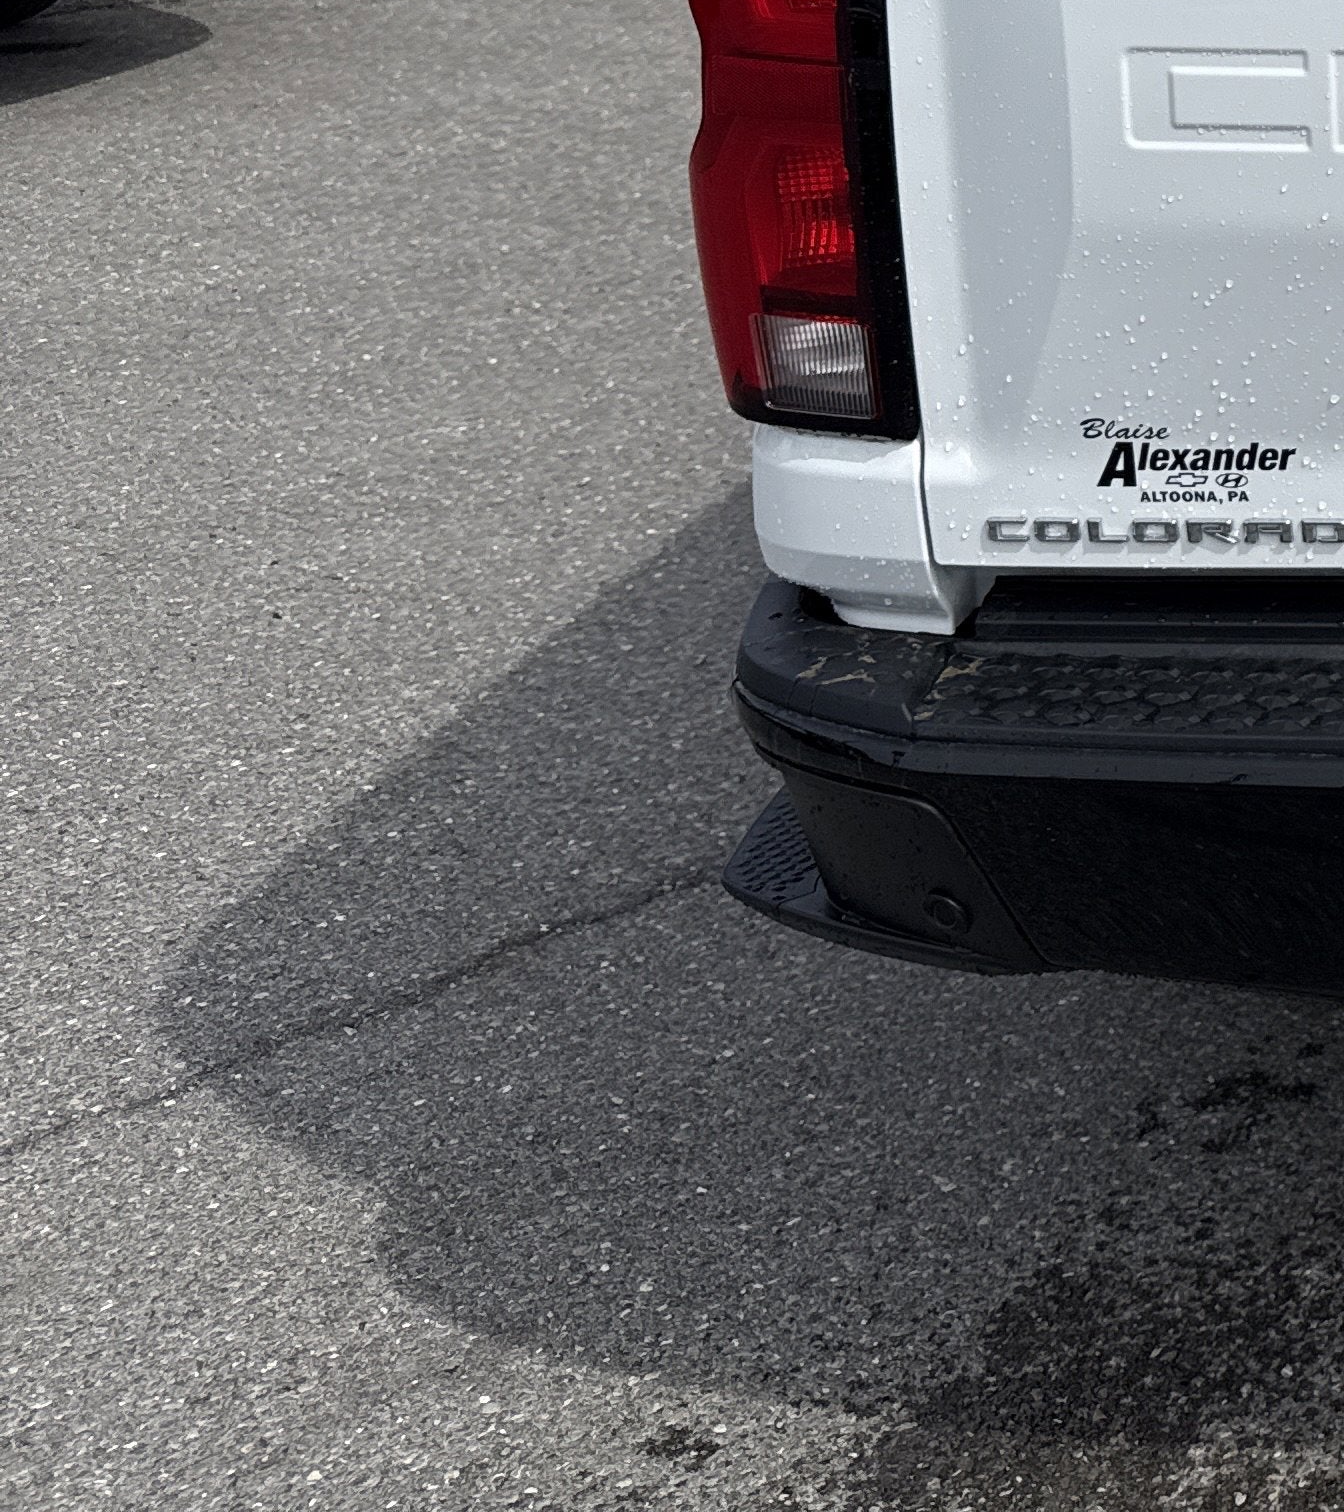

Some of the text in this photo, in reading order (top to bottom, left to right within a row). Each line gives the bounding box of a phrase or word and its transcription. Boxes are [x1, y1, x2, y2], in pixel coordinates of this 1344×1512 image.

[1079, 417, 1170, 439] Blaise
[1096, 441, 1298, 487] Alexander
[1140, 490, 1250, 504] ALTOONA, PA
